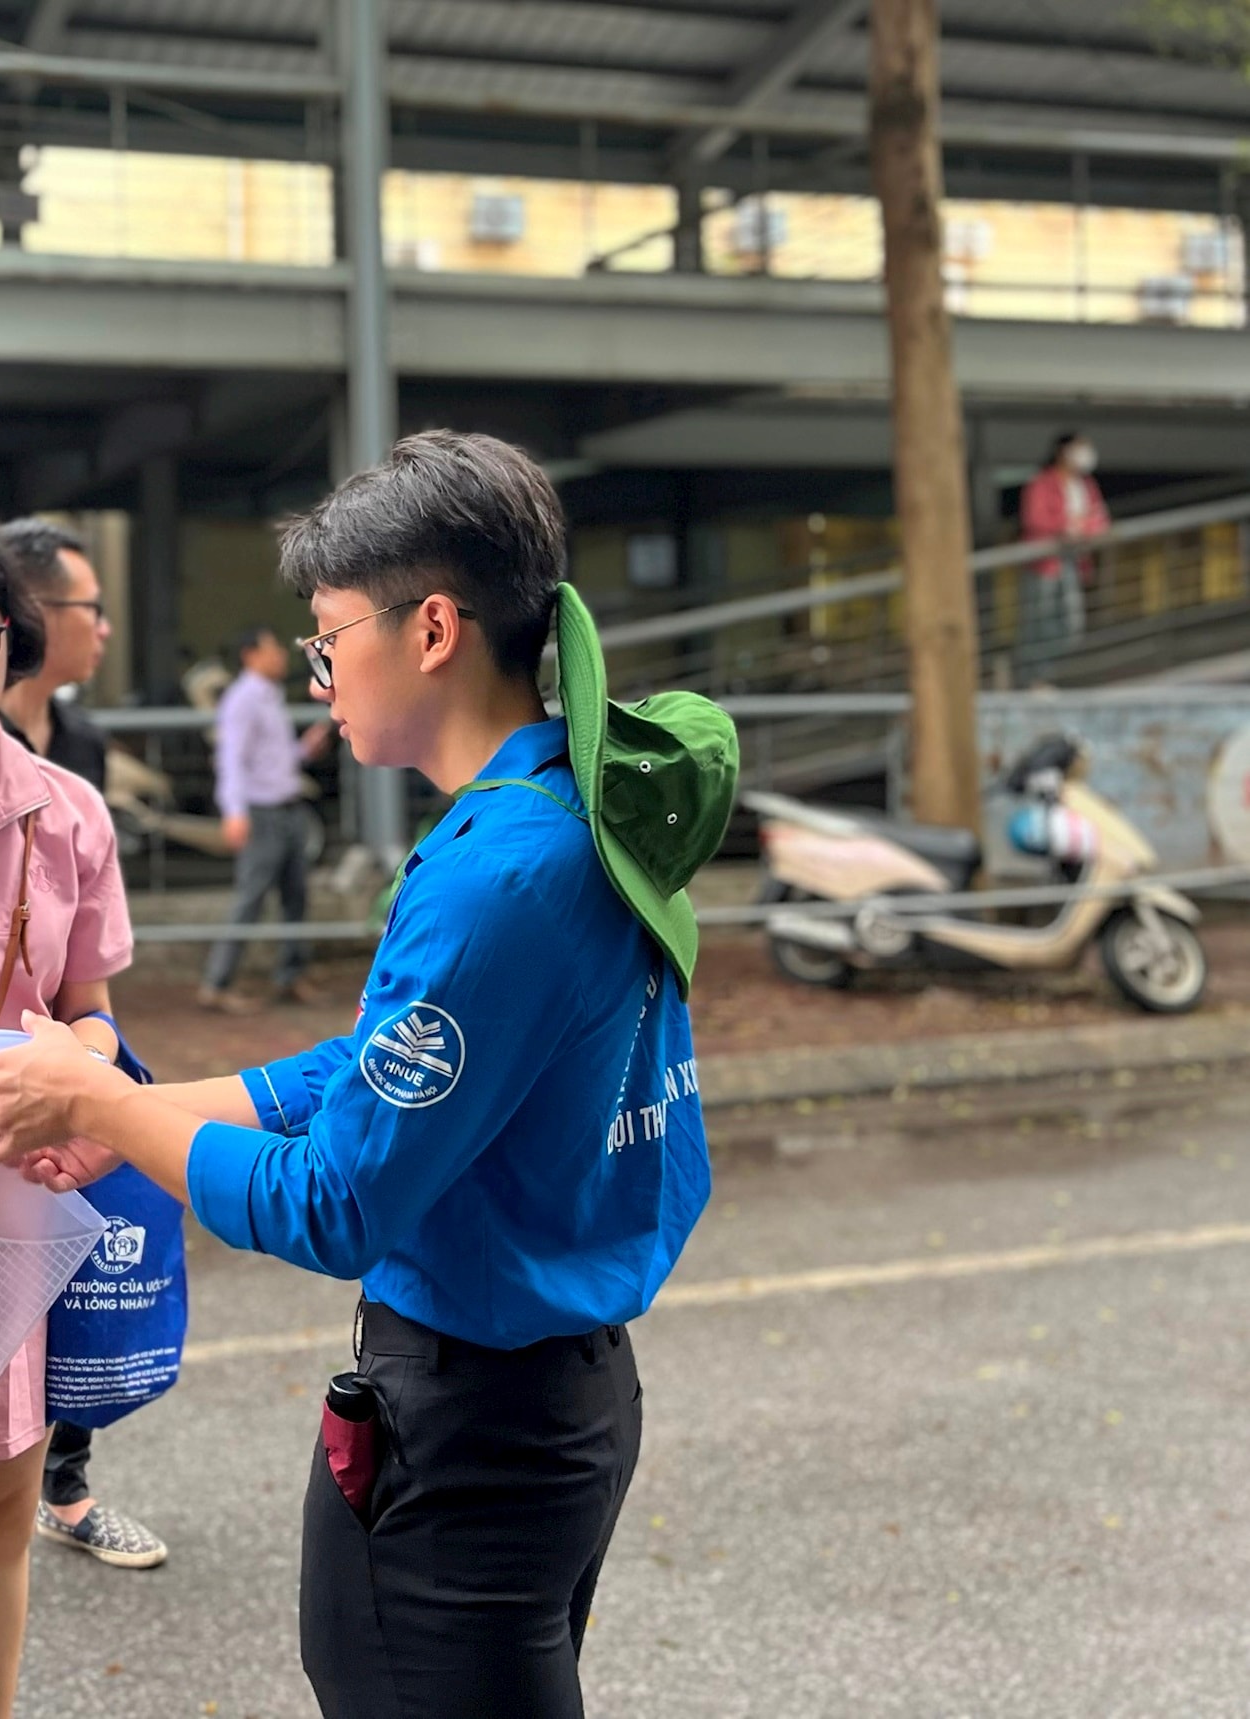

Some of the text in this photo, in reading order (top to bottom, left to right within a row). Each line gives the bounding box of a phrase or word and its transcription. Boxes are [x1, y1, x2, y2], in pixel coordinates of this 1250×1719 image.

[383, 1060, 425, 1087] HNUE
[70, 1279, 117, 1294] TRƯỜNG
[119, 1277, 144, 1294] CỦA
[63, 1296, 82, 1310] VÀ
[84, 1296, 118, 1310] LÒNG
